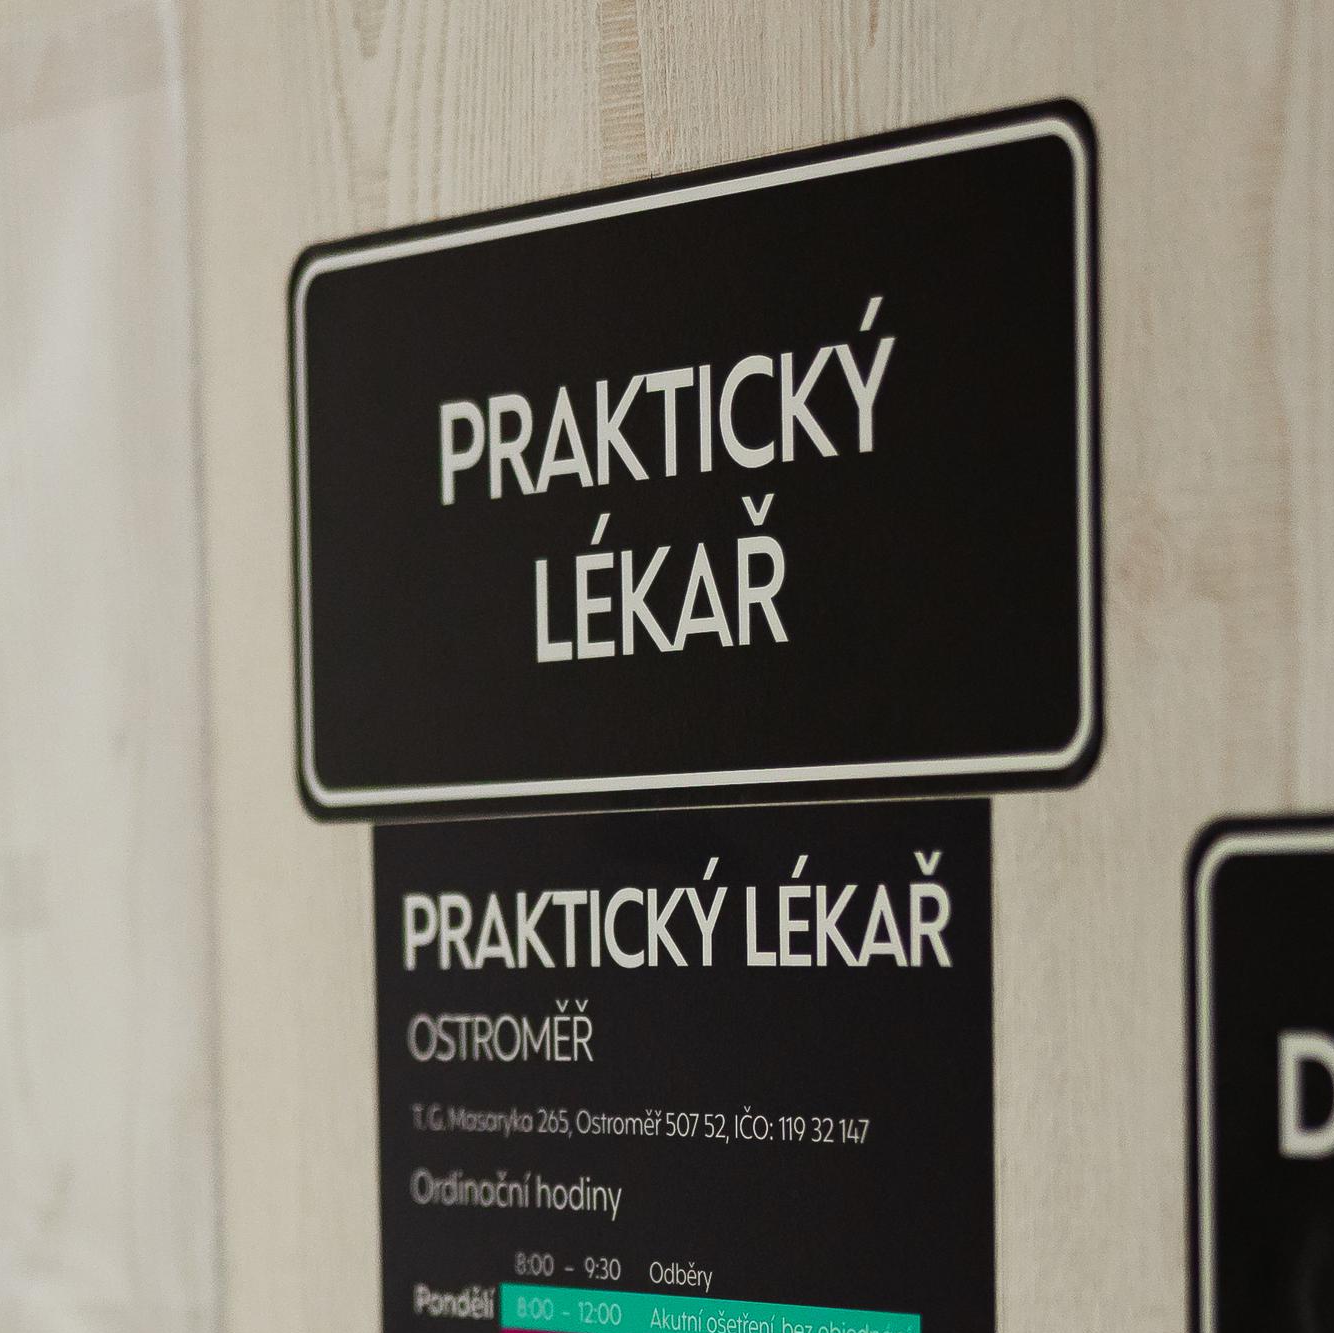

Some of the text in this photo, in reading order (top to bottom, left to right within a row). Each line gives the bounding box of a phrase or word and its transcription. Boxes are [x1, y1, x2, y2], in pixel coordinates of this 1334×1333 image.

[439, 296, 895, 506] PRAKTICKÝ
[535, 493, 789, 663] LÉKAŘ
[403, 851, 952, 970] PRAKTICKÝ LÉKAŘ
[407, 1000, 594, 1062] OSTROMĚŘ
[447, 1104, 534, 1139] Masaryka
[536, 1107, 573, 1139] 265,
[576, 1108, 662, 1136] Ostroměř
[666, 1112, 699, 1138] 507
[704, 1114, 730, 1144] 52,
[734, 1106, 774, 1141] IČO:
[778, 1116, 805, 1142] 119
[811, 1117, 835, 1143] 32
[839, 1119, 870, 1144] 147
[410, 1167, 622, 1221] Ordinační hodiny
[515, 1252, 555, 1276] 8:00
[585, 1257, 621, 1280] 9:30
[649, 1261, 713, 1293] Odběry
[414, 1282, 496, 1320] Pondělí
[517, 1296, 554, 1320] 8:00
[578, 1301, 622, 1325] 12:00
[650, 1307, 703, 1333] Akutní
